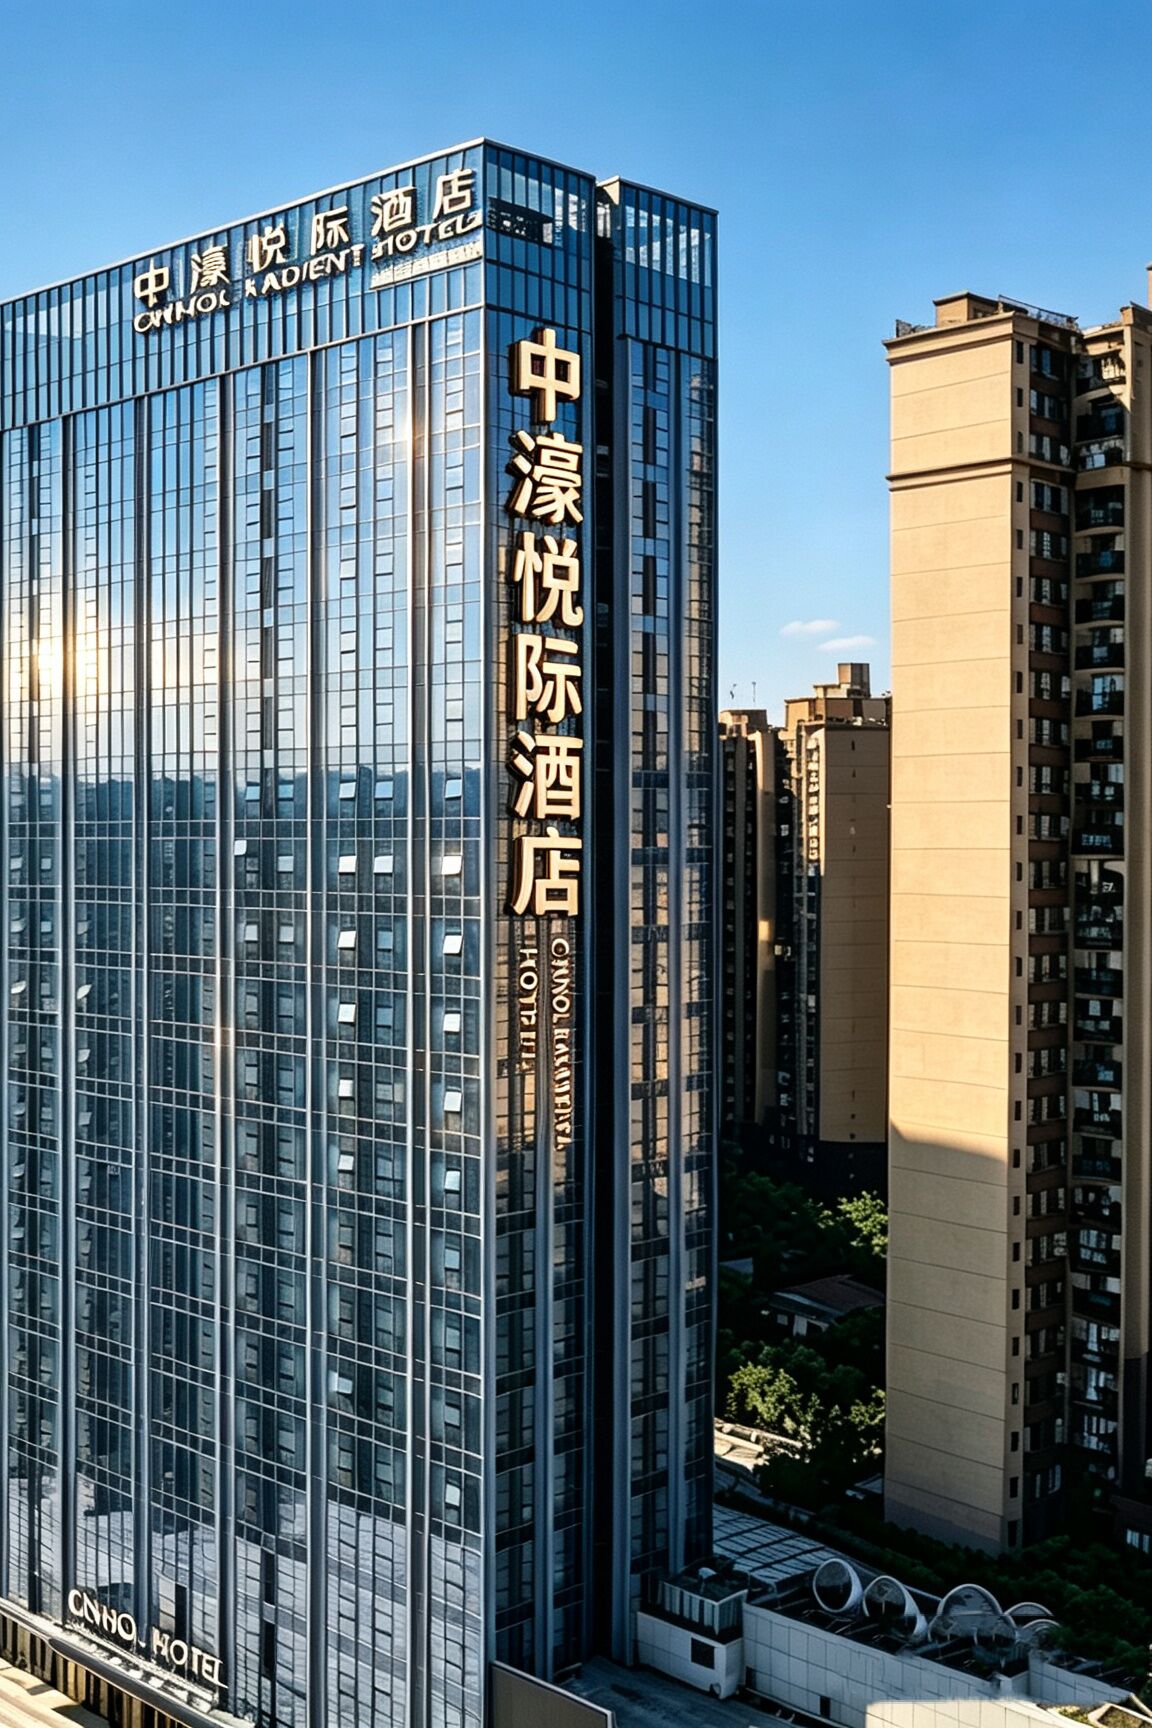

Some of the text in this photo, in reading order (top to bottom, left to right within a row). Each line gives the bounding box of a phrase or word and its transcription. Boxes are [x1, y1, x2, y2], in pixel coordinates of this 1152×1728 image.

[133, 168, 475, 308] 中濠悦际酒店
[510, 327, 584, 918] 中濠悦际酒店
